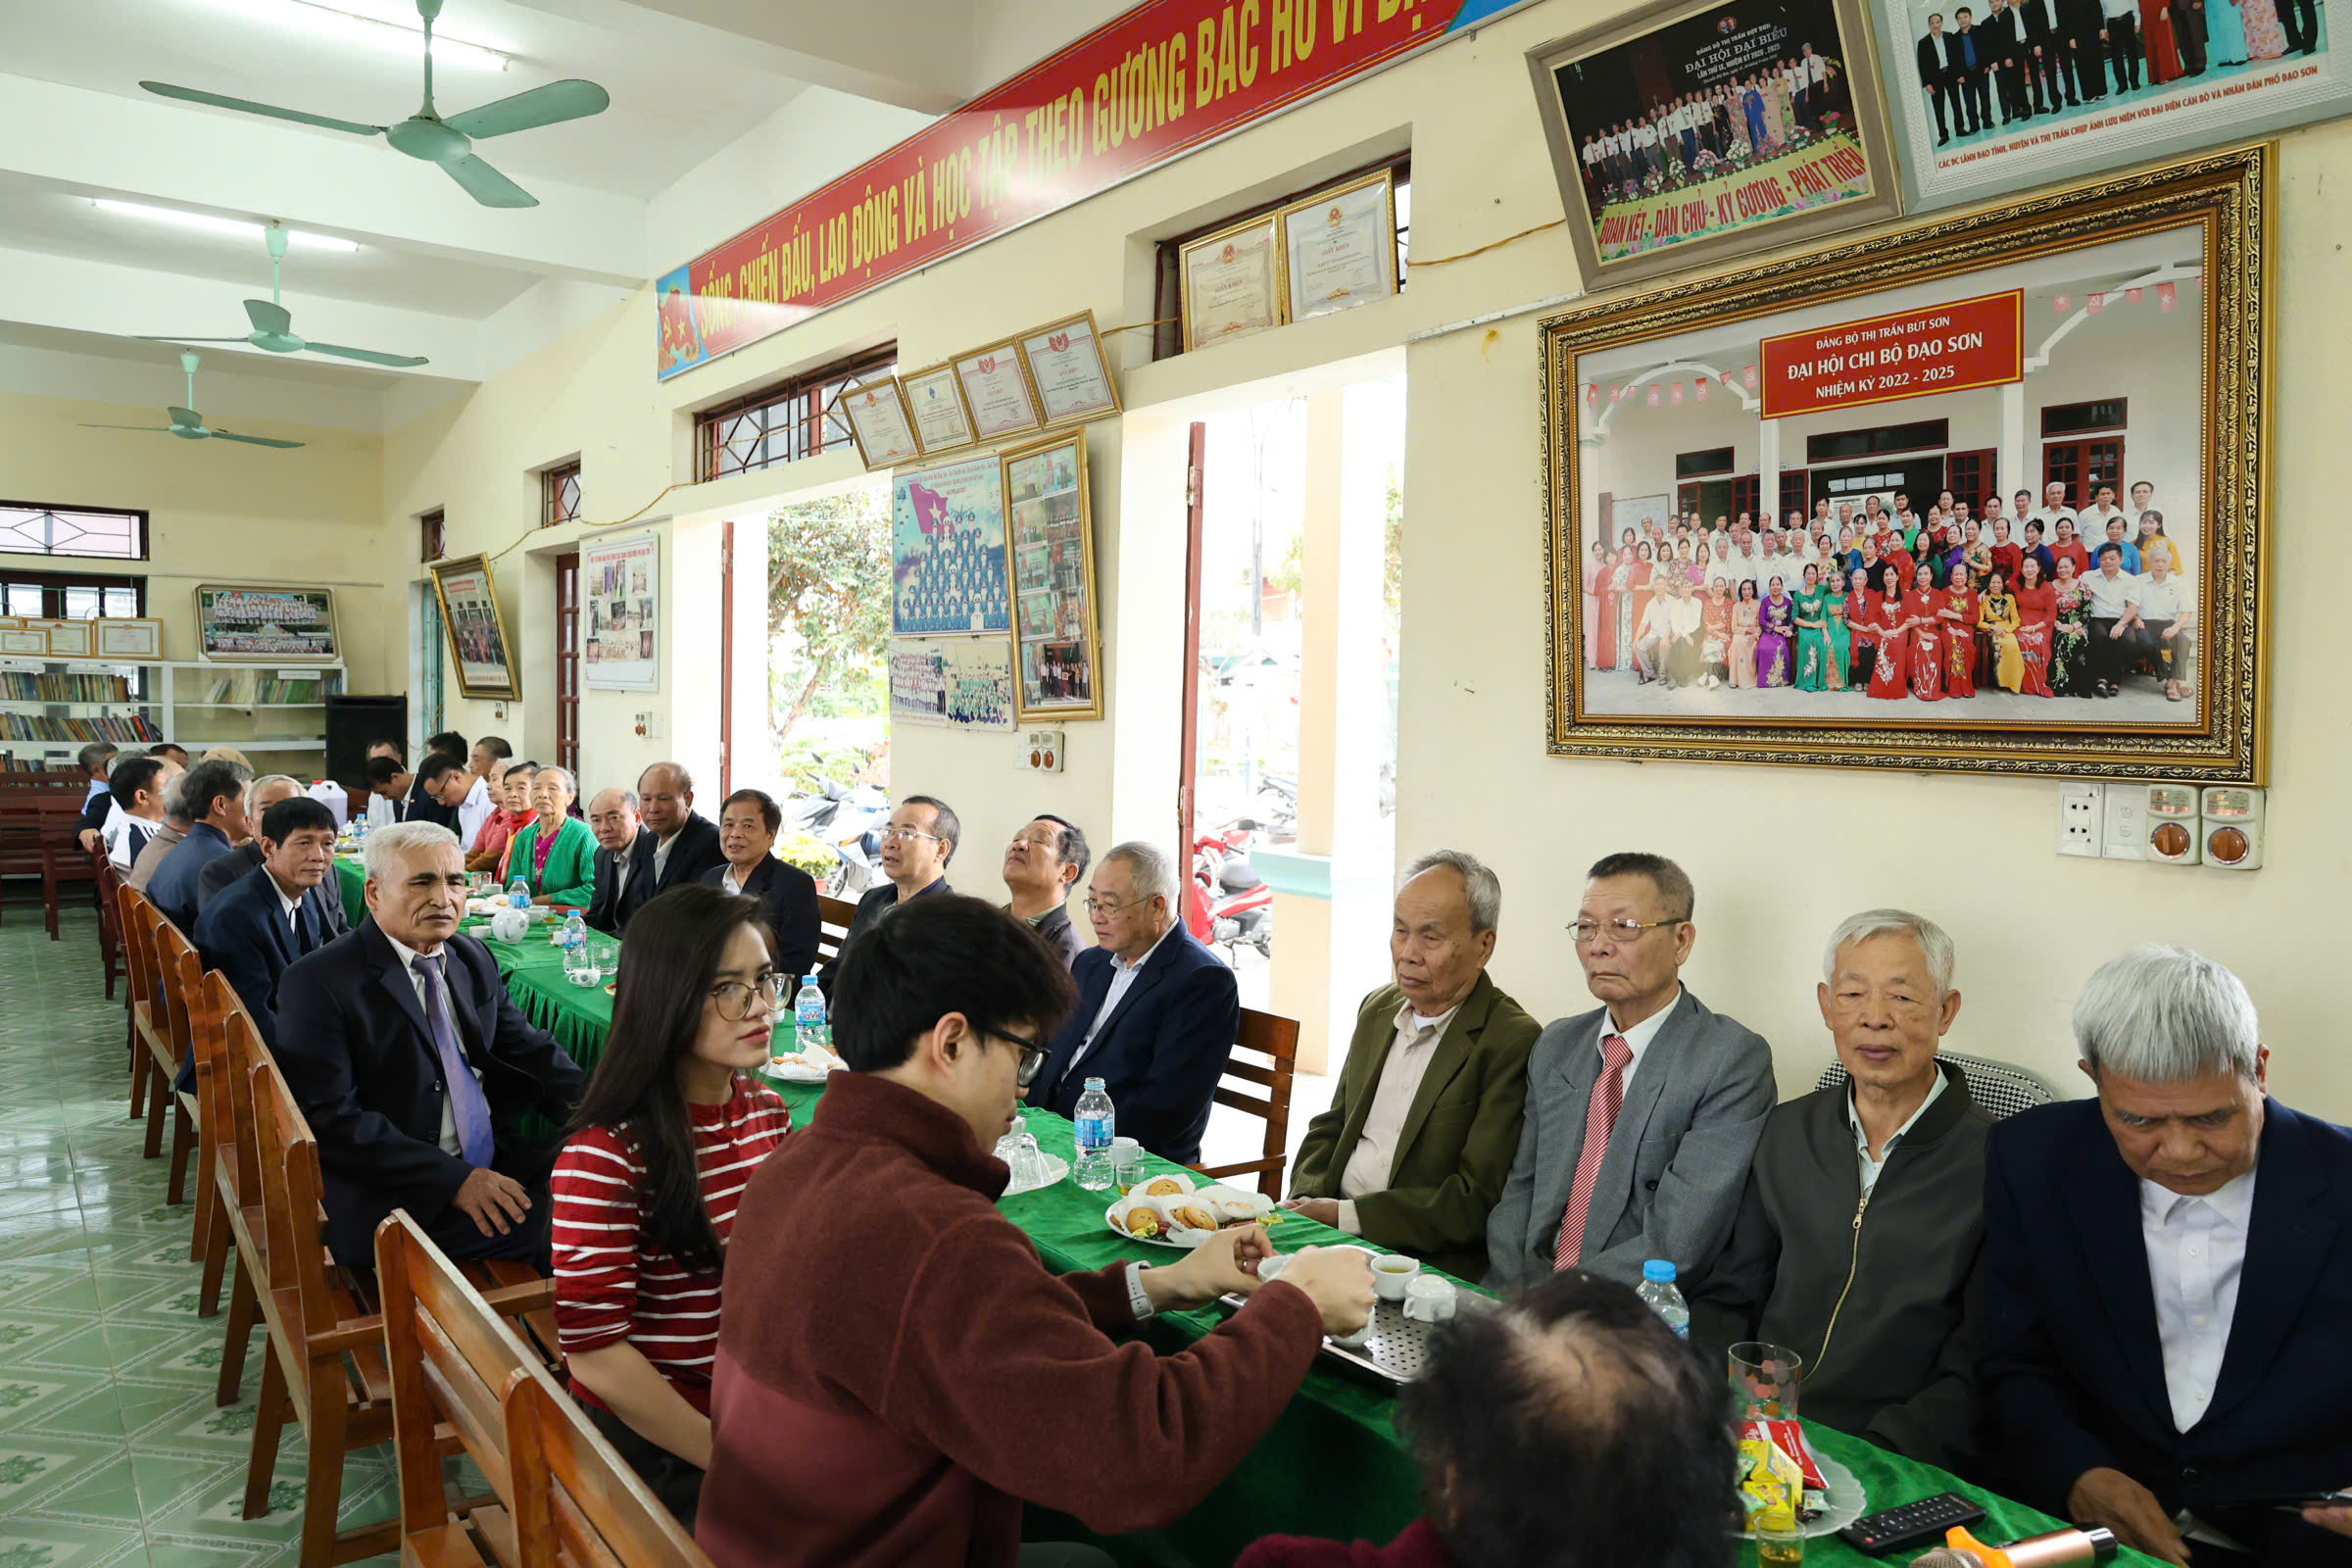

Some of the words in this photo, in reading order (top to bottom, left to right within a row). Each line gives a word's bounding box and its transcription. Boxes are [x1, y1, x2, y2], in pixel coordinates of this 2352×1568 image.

[1686, 57, 1707, 74] ĐẠI
[1709, 48, 1732, 64] HỘI
[1734, 38, 1756, 54] ĐẠI
[1758, 25, 1788, 46] BIỂU
[1938, 159, 1950, 169] CÁC
[1960, 153, 1977, 164] LÃNH
[1977, 149, 1990, 160] ĐẠO
[2009, 138, 2030, 151] HUYỆN
[2030, 135, 2039, 145] VÀ
[2040, 132, 2051, 143] THỊ
[2052, 126, 2070, 139] TRẤN
[2071, 124, 2087, 135] CHỤP
[2089, 120, 2103, 131] ẢNH
[2105, 116, 2118, 126] LƯU
[2119, 112, 2135, 123] NIỆM
[2137, 107, 2150, 118] VỚI
[2151, 104, 2164, 115] ĐẠI
[2165, 99, 2181, 112] DIỆN
[2182, 95, 2197, 107] CÁN
[2199, 91, 2210, 103] BỘ
[2211, 88, 2222, 99] VÀ
[2223, 83, 2244, 97] NHÂN
[2246, 77, 2262, 91] DÂN
[2264, 73, 2280, 86] PHỐ
[2281, 70, 2299, 82] ĐẠO
[2300, 65, 2318, 77] SƠN
[782, 212, 815, 302] ĐẤU,
[819, 212, 848, 284] LAO
[852, 183, 899, 278] ĐỘNG
[904, 156, 927, 244] VÀ
[932, 146, 972, 241] HỌC
[978, 113, 1019, 220] TẬP
[1025, 86, 1085, 184] THEO
[1092, 31, 1187, 157] GƯƠNG
[1196, 0, 1261, 110] BÁC
[1628, 203, 1648, 243] KẾT
[1655, 203, 1678, 239] DÂN
[1682, 188, 1707, 235] CHỦ
[1716, 180, 1735, 225] KỶ
[1736, 176, 1788, 220] CƯƠNG
[1788, 159, 1828, 198] PHÁT
[1821, 140, 1866, 191] TRIỂN
[1788, 361, 1813, 380] ĐẠI
[1817, 353, 1844, 377] HỘI
[1848, 350, 1875, 369] CHI
[1880, 343, 1903, 367] BỘ
[1907, 339, 1942, 362] ĐẠO
[1947, 331, 1983, 354] SƠN
[1816, 335, 1842, 350] ĐẢNG
[1845, 330, 1859, 347] BỘ
[1861, 326, 1877, 342] THỊ
[1879, 320, 1904, 339] TRẤN
[1907, 318, 1927, 333] BÚT
[1929, 316, 1950, 329] SƠN
[1816, 380, 1855, 399] NHIỆM
[1879, 372, 1909, 390] 2022
[1922, 365, 1955, 381] 2025
